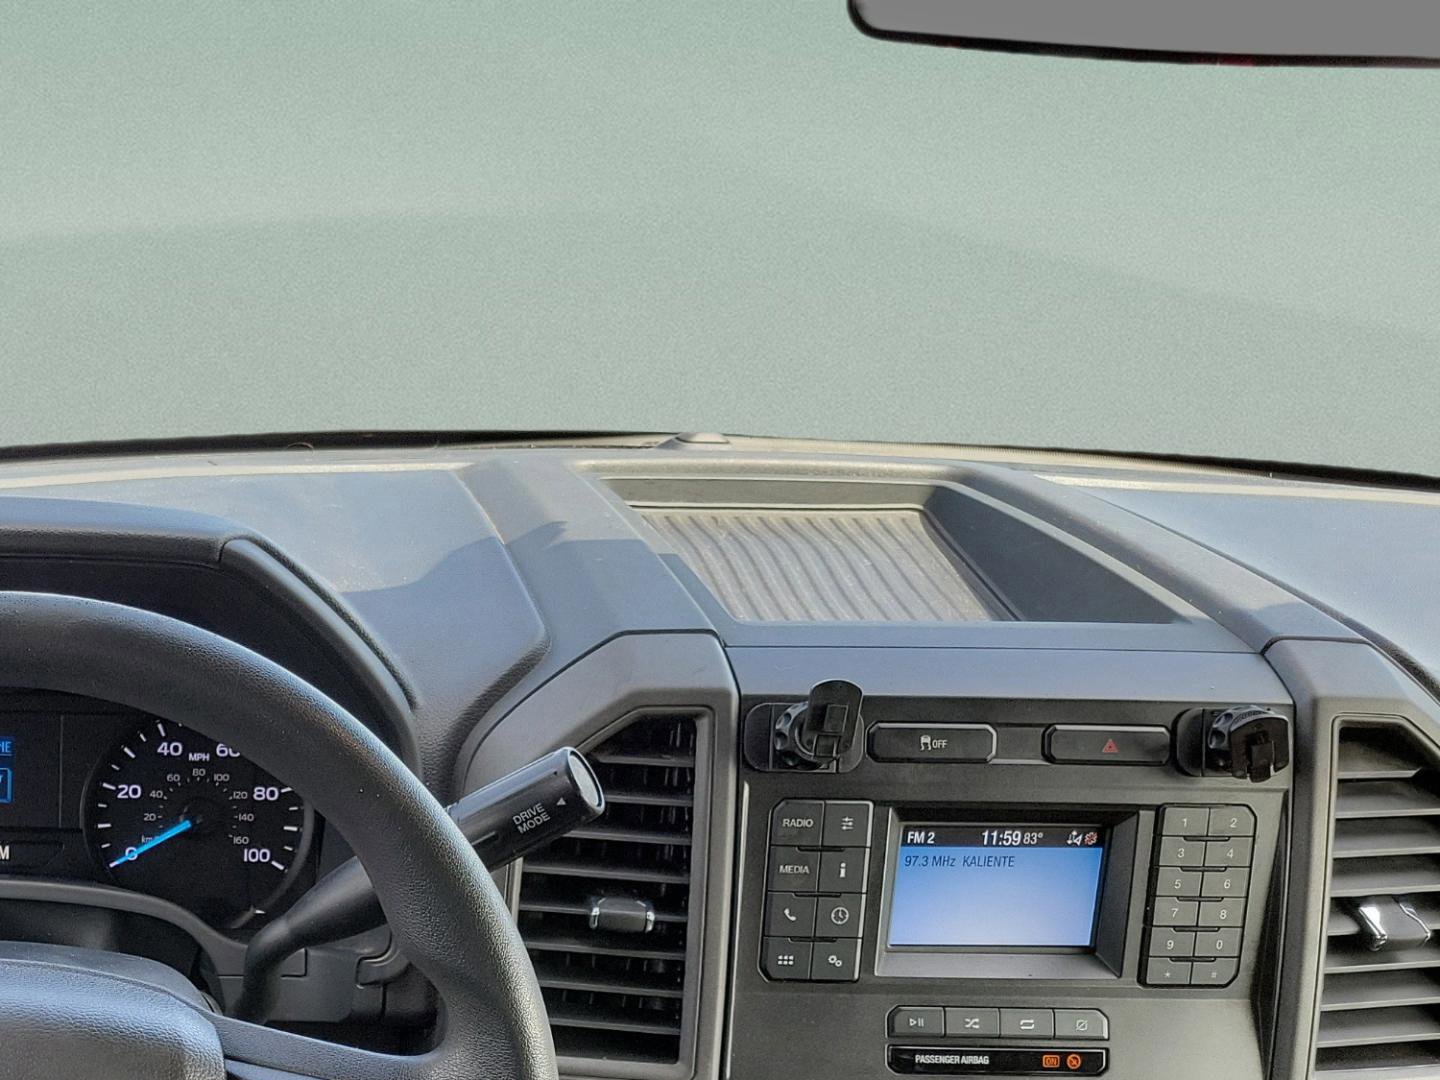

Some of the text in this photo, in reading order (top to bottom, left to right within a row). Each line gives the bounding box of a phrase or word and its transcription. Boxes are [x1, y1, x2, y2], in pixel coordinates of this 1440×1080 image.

[157, 742, 183, 756] 40
[932, 740, 948, 749] OFF
[188, 753, 210, 762] MPH
[166, 773, 180, 782] 60
[192, 768, 206, 777] 80
[213, 774, 230, 782] 100
[117, 785, 142, 799] 20
[149, 790, 164, 799] 40
[233, 790, 248, 800] 120
[253, 787, 279, 801] 80
[143, 813, 157, 822] 20
[238, 813, 254, 822] 140
[512, 803, 545, 825] DRIVE
[517, 812, 550, 833] MODE
[782, 818, 814, 828] RADIO
[1182, 817, 1188, 828] 1
[1229, 817, 1238, 829] 2
[233, 836, 249, 845] 160
[906, 832, 926, 845] FM
[927, 832, 936, 845] 2
[981, 830, 1021, 846] 11:59
[244, 848, 271, 862] 100
[1177, 848, 1185, 859] 3
[1226, 848, 1234, 858] 4
[904, 855, 1016, 868] 97.3 MHz KALIENTE
[779, 864, 810, 875] MEDIA
[1174, 879, 1182, 889] 5
[1223, 879, 1231, 889] 6
[1171, 907, 1178, 918] 7
[1219, 909, 1227, 919] 8
[1166, 939, 1175, 950] 9
[1215, 939, 1224, 950] 0
[914, 1054, 990, 1065] PASSENGER AIRBAG
